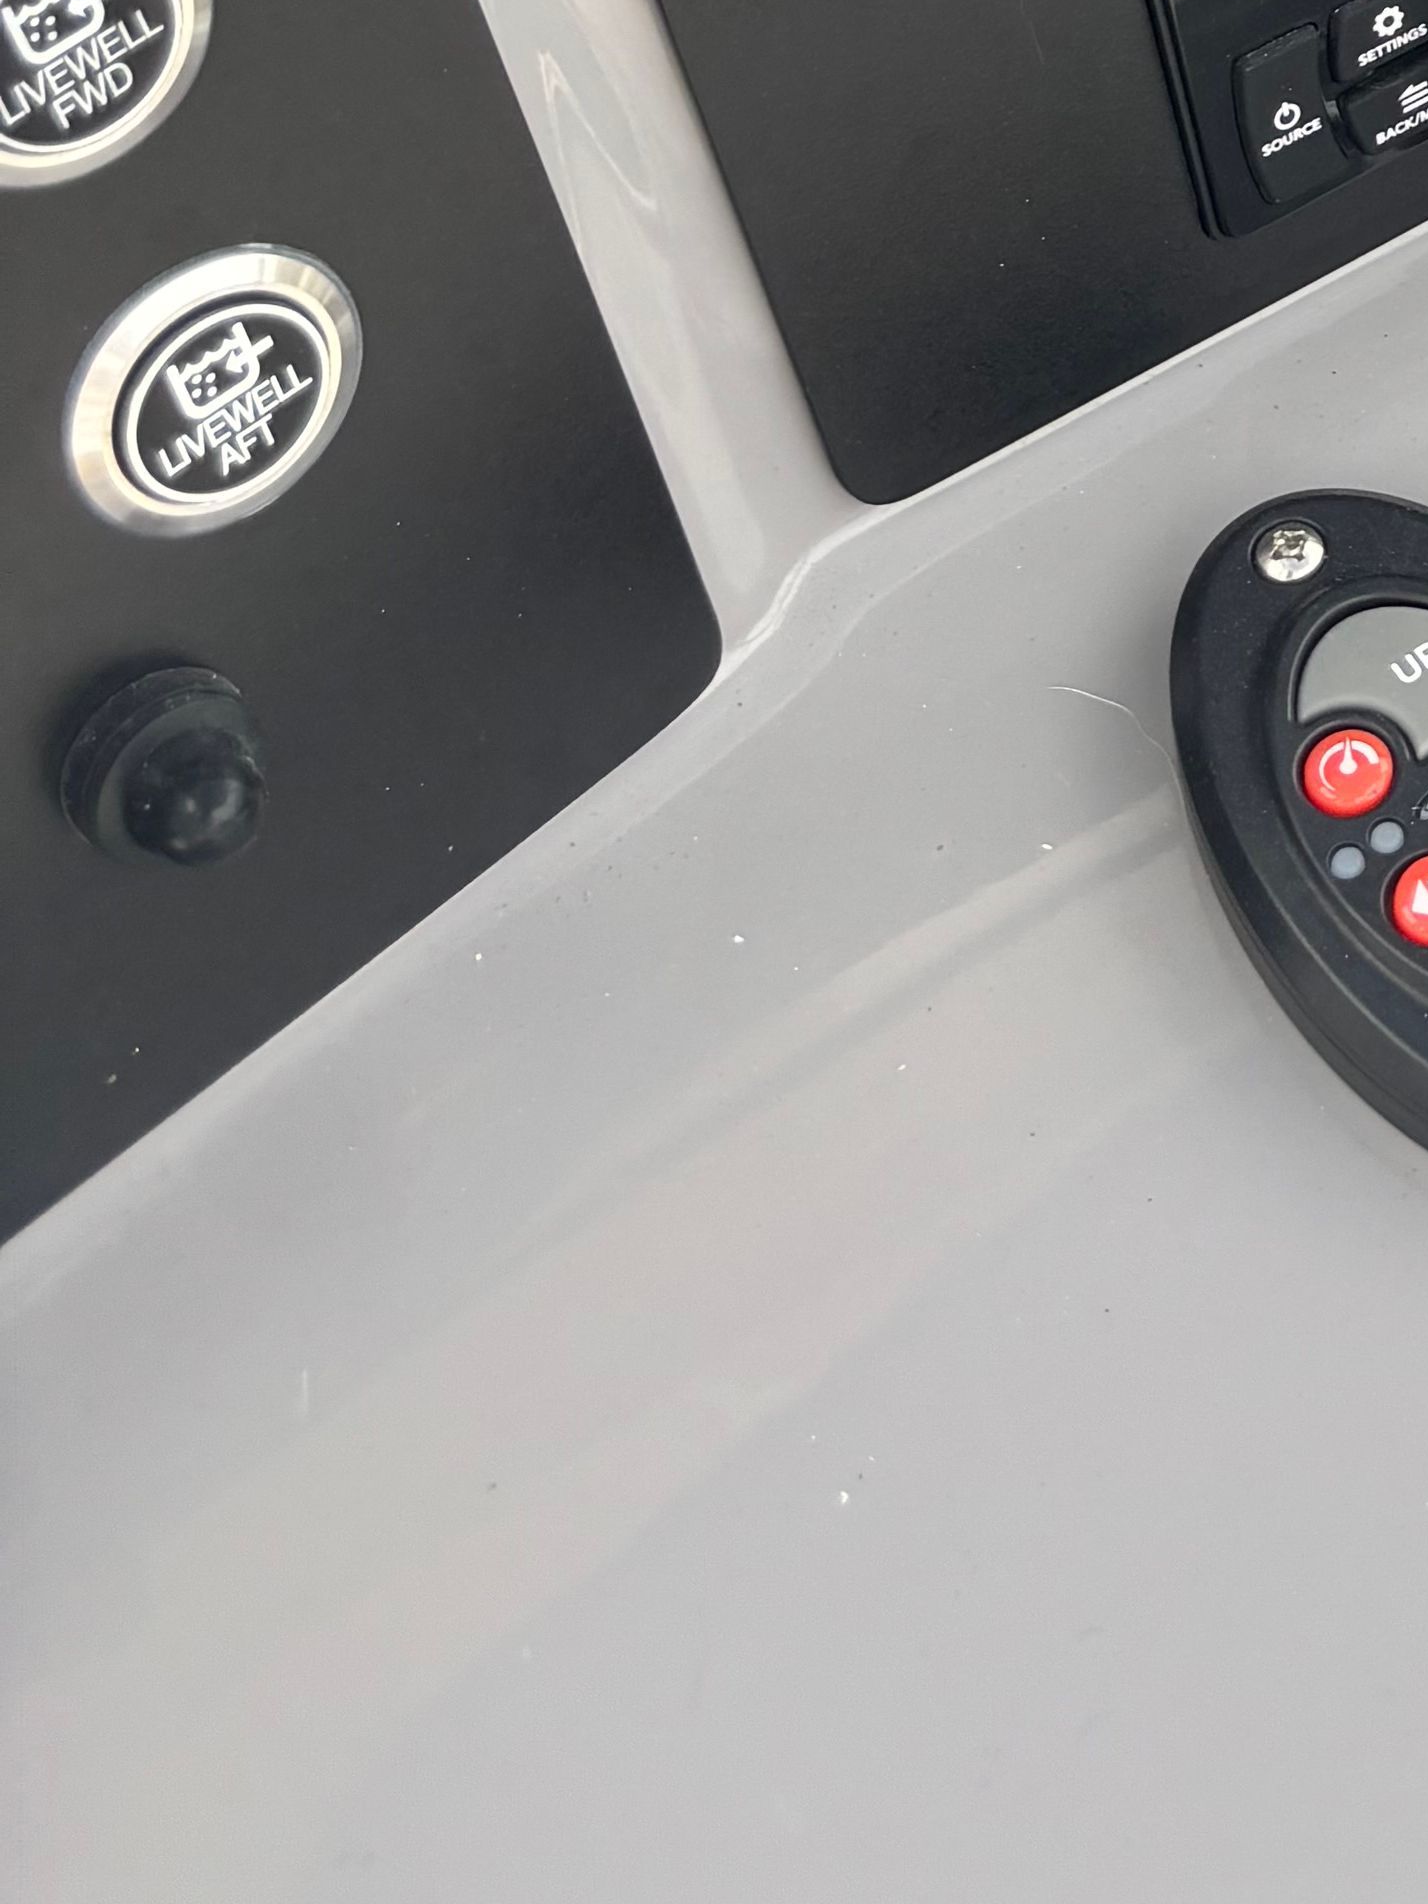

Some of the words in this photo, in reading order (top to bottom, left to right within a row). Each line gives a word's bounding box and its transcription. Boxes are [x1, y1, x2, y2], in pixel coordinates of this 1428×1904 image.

[0, 9, 165, 125] LIVEWELL
[1357, 22, 1428, 69] SETTINGS
[52, 62, 134, 129] FWD
[1261, 117, 1323, 158] SOURCE
[157, 363, 313, 478] LIVEWELL
[217, 414, 281, 478] AFT
